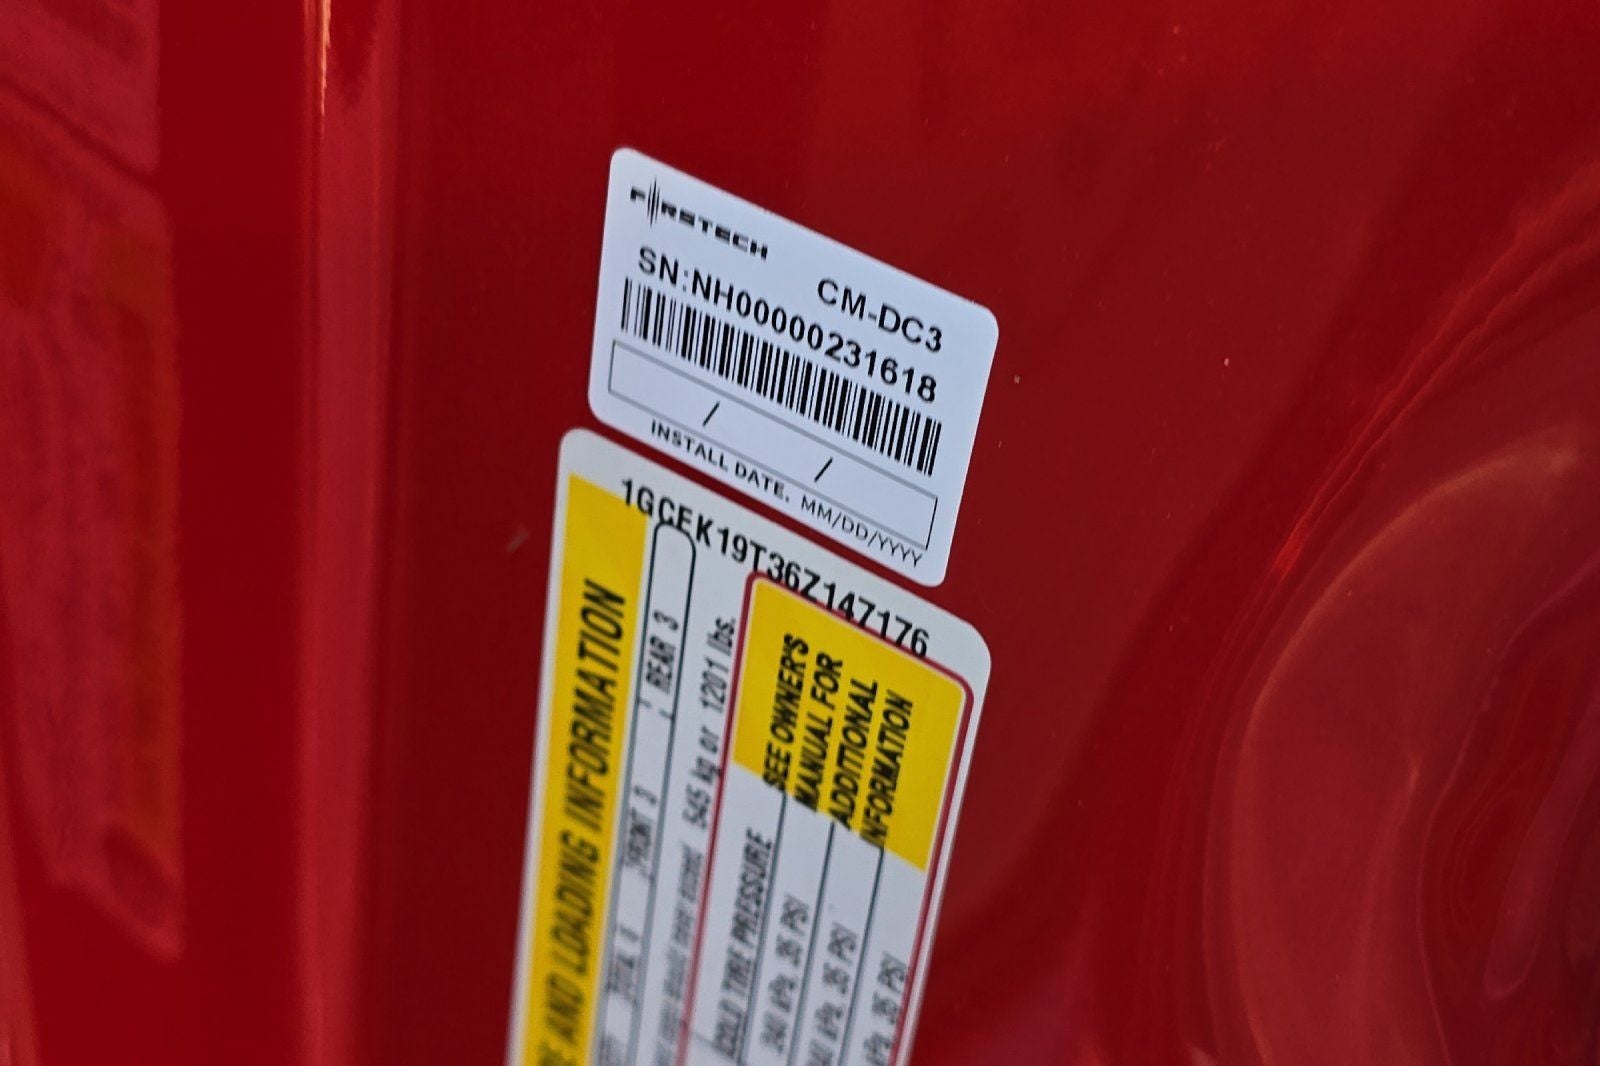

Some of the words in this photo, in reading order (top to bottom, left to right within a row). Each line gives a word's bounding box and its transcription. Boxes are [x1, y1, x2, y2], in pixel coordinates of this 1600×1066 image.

[637, 244, 938, 404] SN:NH00000231618
[816, 278, 944, 354] CM-DC3
[652, 419, 729, 473] INSTALL
[801, 494, 923, 568] MM/DD/YYYY
[621, 479, 931, 659] 1GCEK19T36Z147176
[653, 609, 679, 632] 3
[705, 616, 737, 653] lbs.
[645, 634, 679, 695] REAR
[700, 654, 730, 717] 1201
[769, 632, 810, 735] OWNER'S
[810, 651, 844, 703] FOR
[562, 577, 627, 834] INFORMATION
[699, 726, 719, 753] or
[694, 756, 720, 785] kg
[762, 740, 791, 791] SEE
[793, 703, 834, 814] MANUAL
[828, 677, 879, 831] ADDITIONAL
[859, 690, 914, 849] INFORMATION
[681, 784, 709, 831] 545
[549, 829, 599, 977] LOADING
[730, 827, 772, 949] PRESSURE
[544, 970, 586, 1046] AND
